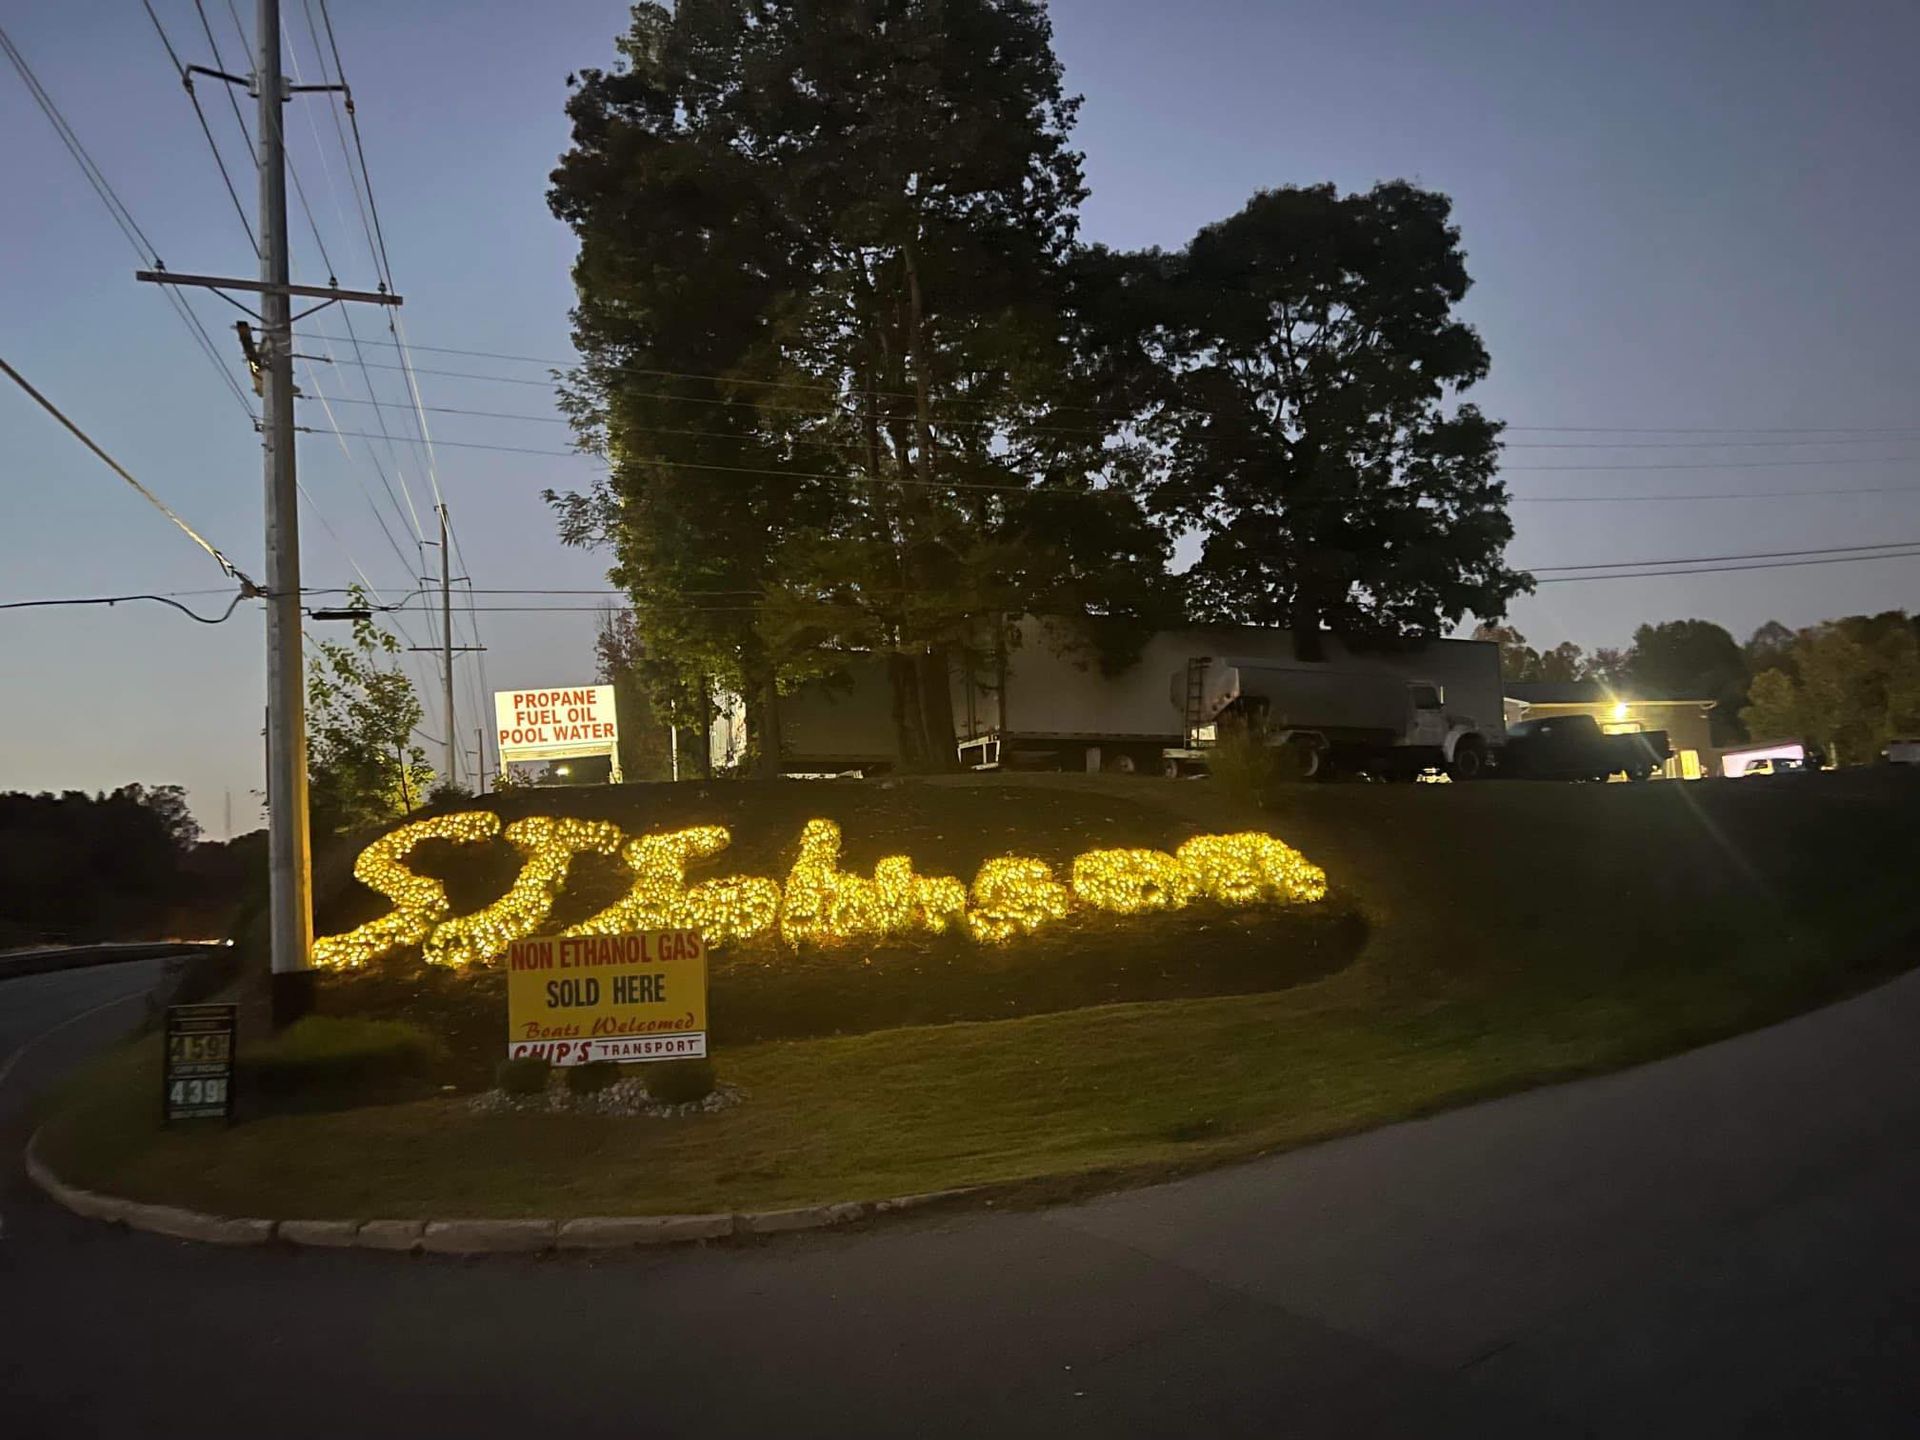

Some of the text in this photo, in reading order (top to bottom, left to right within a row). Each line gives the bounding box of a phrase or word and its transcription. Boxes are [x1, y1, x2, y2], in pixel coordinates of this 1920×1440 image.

[514, 690, 597, 709] PROPANE
[516, 707, 597, 726] FUEL OIL
[499, 723, 615, 745] POOL WATER
[511, 932, 700, 971] NON ETHANOL GAS
[546, 974, 666, 1008] SOLD HERE
[521, 1012, 695, 1039] Boats Welcomed
[598, 1040, 698, 1056] TRANSPORT
